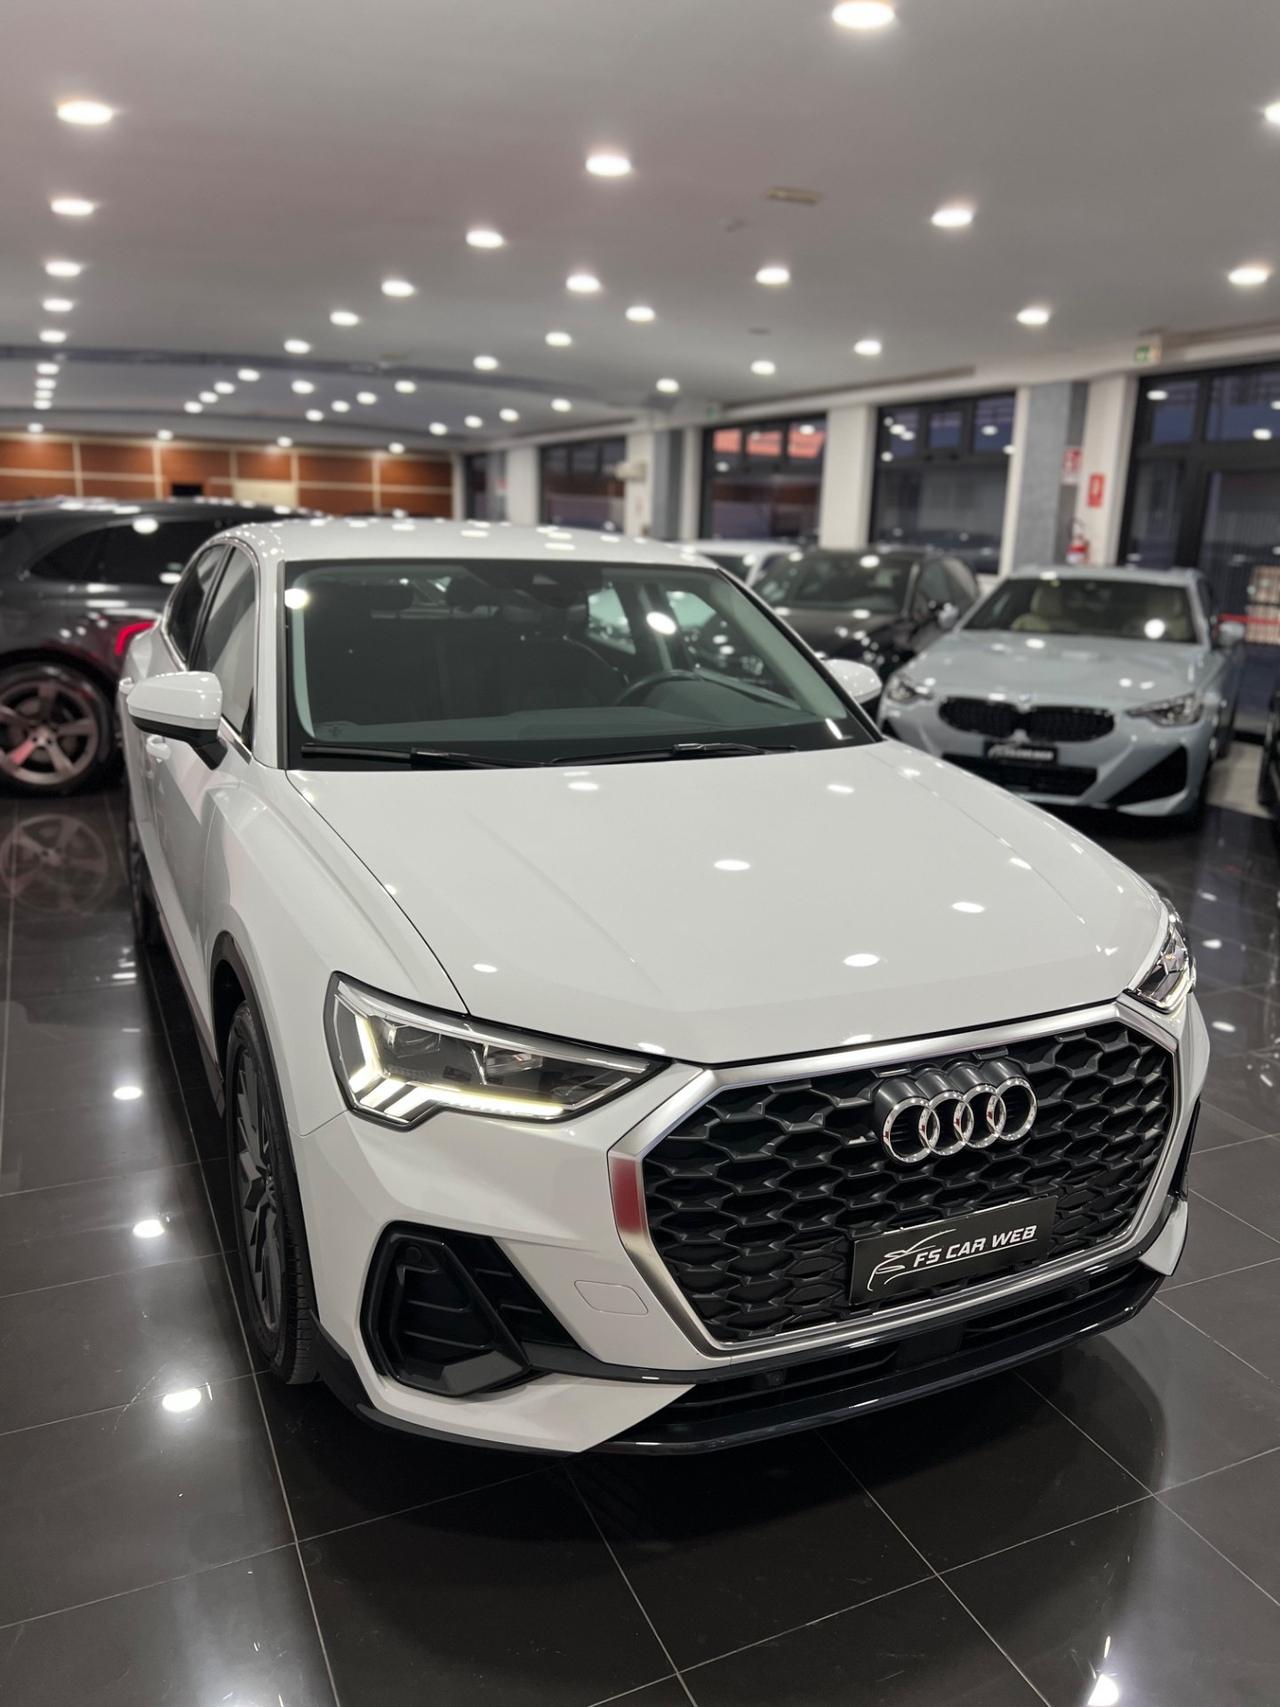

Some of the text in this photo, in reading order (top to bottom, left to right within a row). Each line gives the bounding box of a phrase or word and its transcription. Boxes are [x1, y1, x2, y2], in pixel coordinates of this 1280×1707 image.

[913, 1225, 1037, 1268] FS CAR WEB
